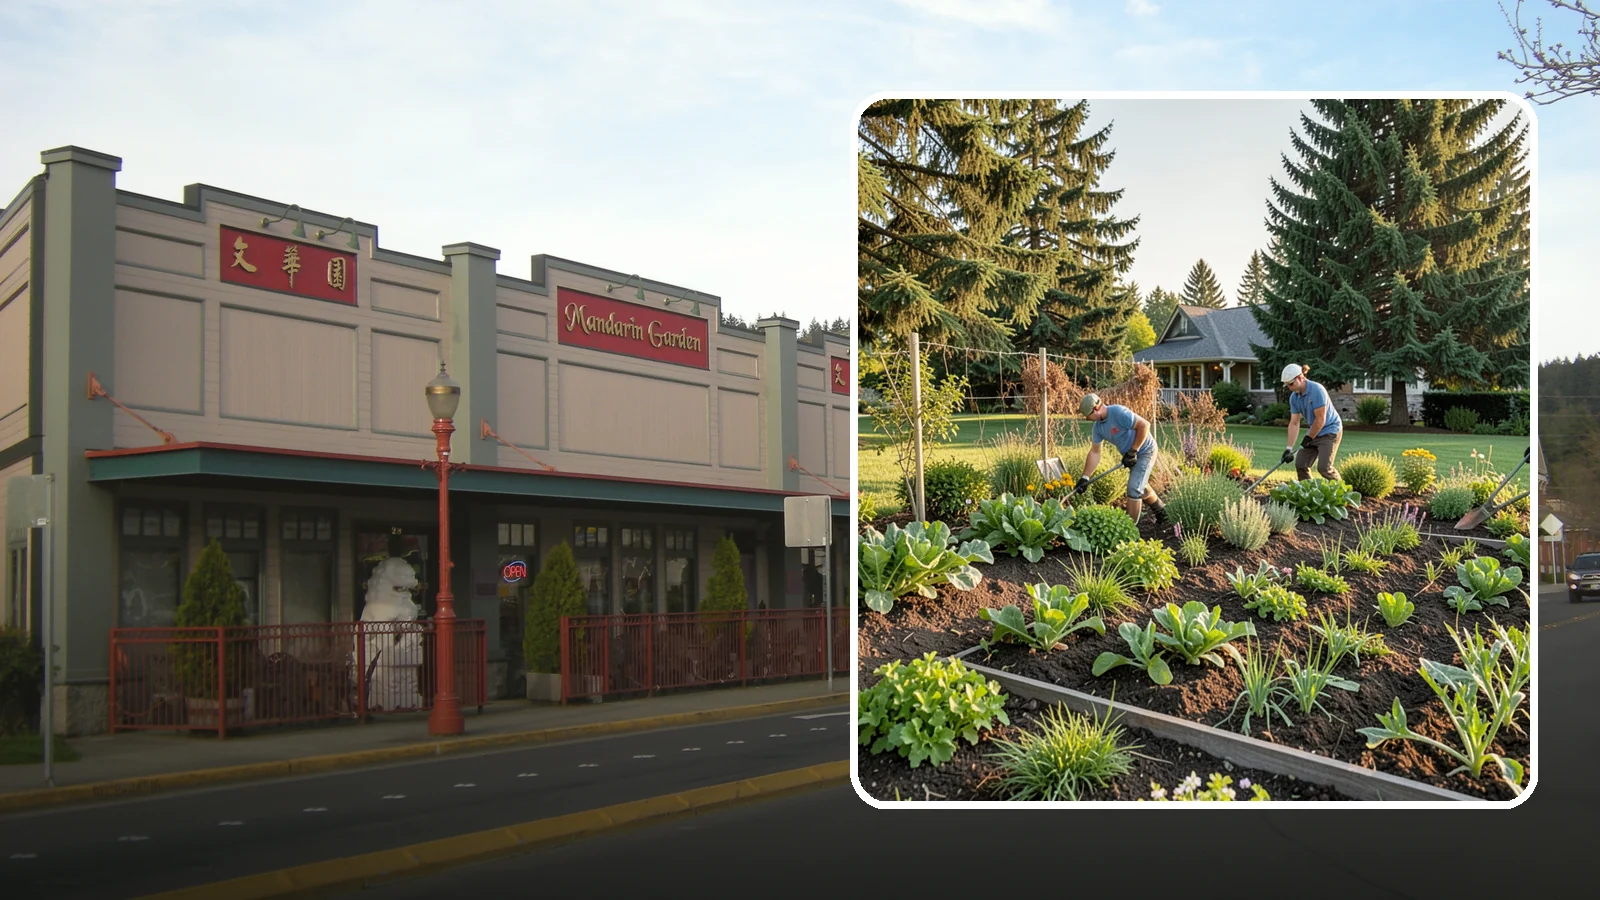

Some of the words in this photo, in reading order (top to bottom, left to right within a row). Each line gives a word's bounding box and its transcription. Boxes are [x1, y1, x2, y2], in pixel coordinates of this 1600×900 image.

[231, 235, 346, 291] 文華園
[564, 302, 644, 341] Mandarin
[648, 320, 701, 352] Garden
[835, 363, 846, 386] 文
[503, 565, 527, 578] OPEN
